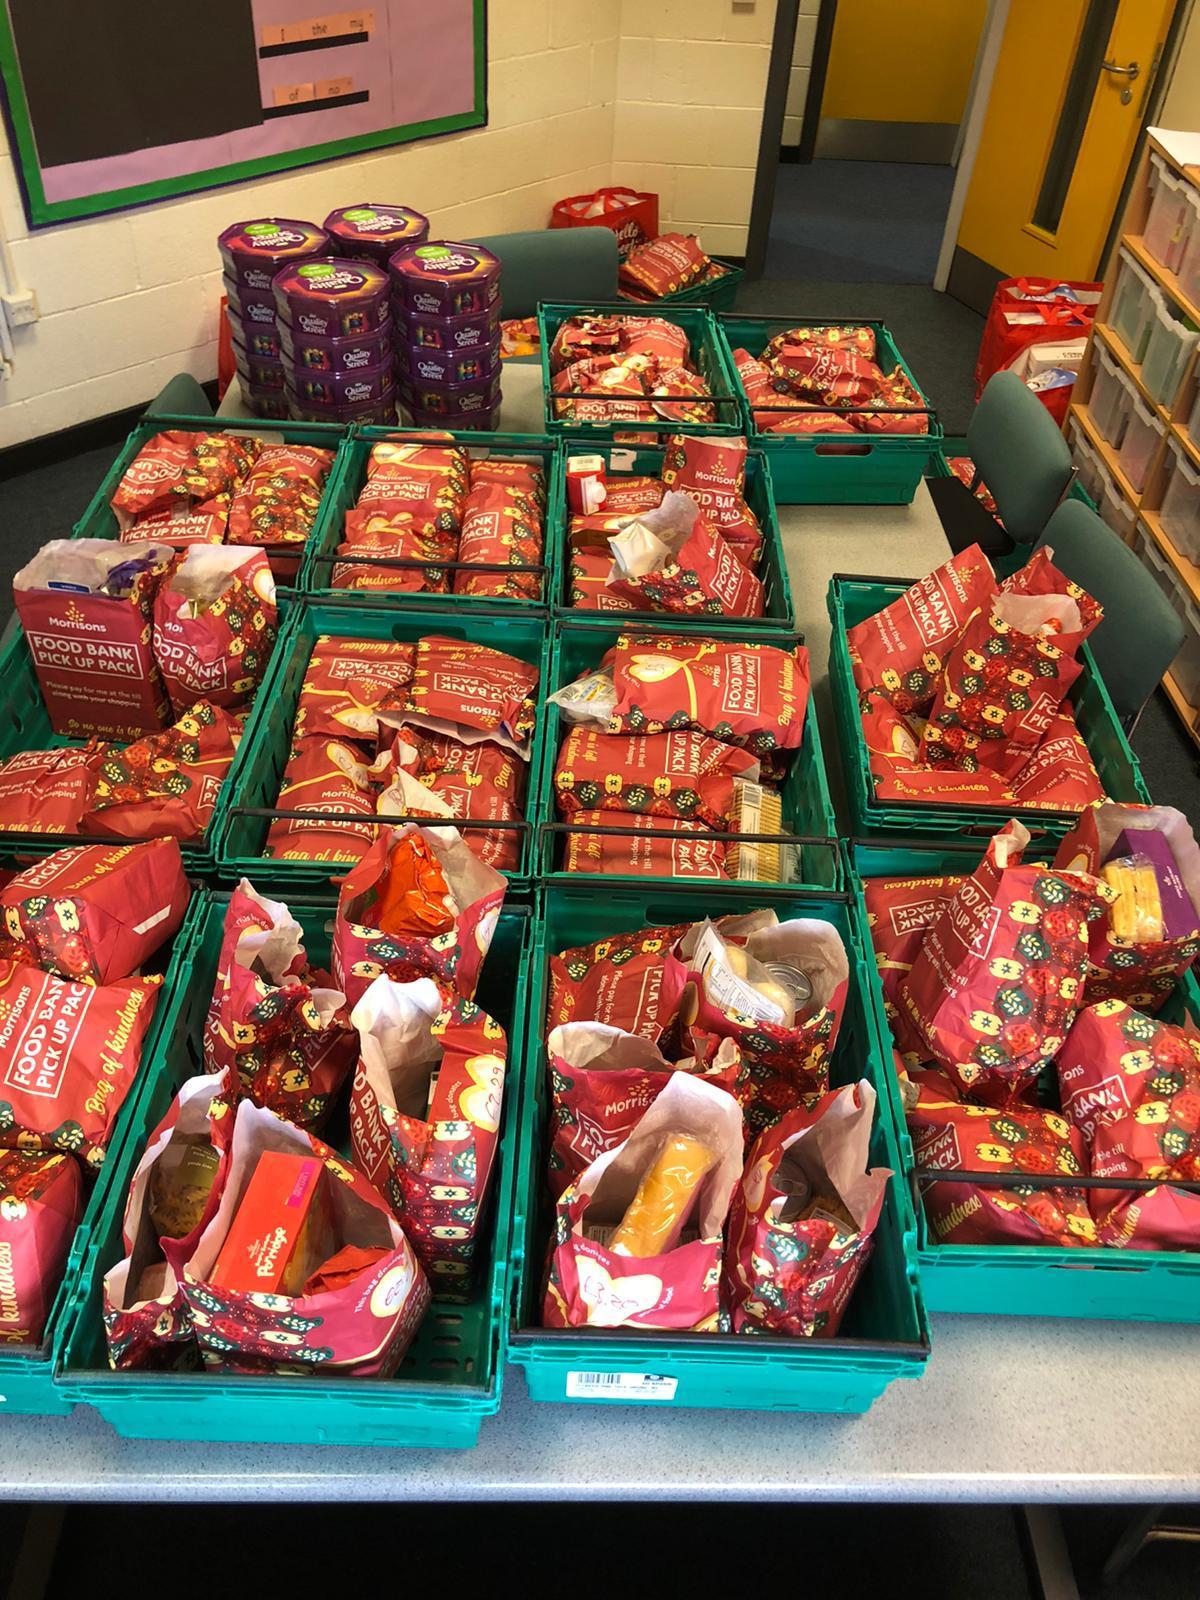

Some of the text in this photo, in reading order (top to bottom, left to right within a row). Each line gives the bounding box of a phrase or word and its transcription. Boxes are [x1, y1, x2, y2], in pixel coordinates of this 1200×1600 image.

[312, 23, 328, 36] the
[350, 19, 364, 31] my
[289, 85, 340, 101] of no
[394, 484, 427, 493] BANK
[695, 471, 737, 485] Morrison
[151, 528, 169, 537] UP
[172, 524, 204, 535] PACK
[716, 555, 731, 592] FOOD
[724, 573, 739, 601] PICK
[918, 605, 939, 640] PACK
[928, 588, 953, 634] BANK
[49, 616, 107, 633] Morrisons
[34, 636, 135, 661] FOOD BANK
[390, 643, 404, 654] of
[38, 651, 137, 674] PICK UP PACK
[188, 655, 222, 679] BANK
[338, 662, 369, 670] PACK
[46, 681, 69, 690] Please
[169, 661, 222, 690] UP PACK
[441, 675, 479, 685] PACK
[743, 658, 756, 711] PICK UP PACK
[440, 682, 487, 697] BANK
[727, 675, 742, 709] FOOD
[778, 658, 797, 726] Bag of kindness
[83, 723, 95, 731] no
[1029, 714, 1052, 730] PIC
[672, 733, 685, 771] UP PACK
[70, 780, 82, 788] till
[493, 764, 513, 789] Bag
[893, 778, 919, 796] Bag
[937, 783, 990, 793] kindness
[488, 809, 497, 820] the
[584, 842, 600, 859] left
[643, 845, 653, 870] the till
[695, 844, 713, 874] BANK
[29, 859, 62, 886] PICK
[95, 859, 112, 874] of
[884, 876, 962, 890] of kindness
[604, 970, 623, 1014] Please pay for
[0, 985, 31, 1049] Morrisons
[639, 970, 664, 1040] PICK UP PAC
[14, 976, 67, 1085] FOOD BAN
[36, 983, 87, 1088] PICK UP PAC
[85, 988, 145, 1115] Bag of kindness
[446, 1081, 463, 1104] donates
[1075, 1086, 1121, 1119] BANK
[361, 1091, 386, 1151] BANK
[353, 1116, 378, 1166] PACK
[917, 1134, 953, 1164] BANK
[1112, 1143, 1125, 1155] till
[933, 1195, 983, 1239] kindness
[256, 1226, 287, 1277] Porridge
[1, 1242, 19, 1322] kindness
[354, 1279, 379, 1313] This bag
